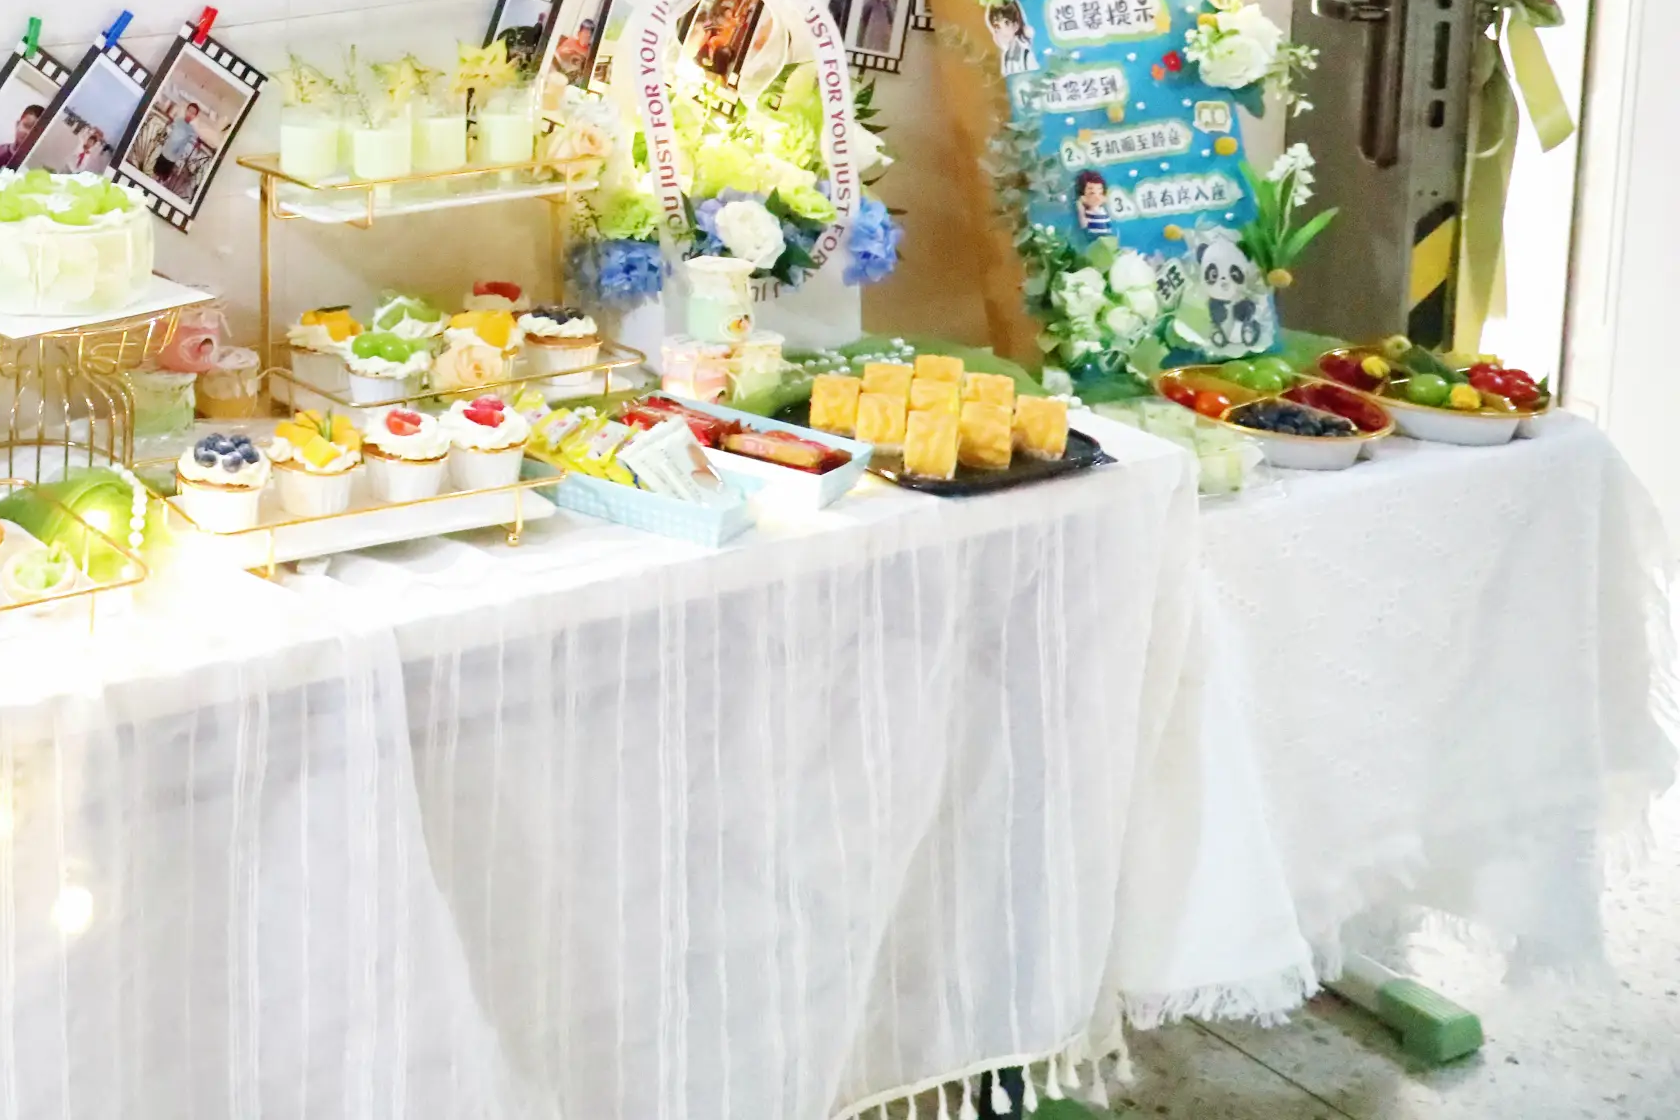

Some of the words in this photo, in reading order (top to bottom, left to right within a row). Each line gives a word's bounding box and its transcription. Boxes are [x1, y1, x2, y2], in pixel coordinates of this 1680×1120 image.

[802, 5, 835, 51] UST
[639, 29, 659, 76] YOU
[822, 58, 844, 103] FOR
[644, 83, 667, 129] FOR
[830, 108, 849, 156] YOU
[654, 135, 678, 188] JUST
[831, 161, 852, 217] JUST
[810, 223, 845, 270] FOR
